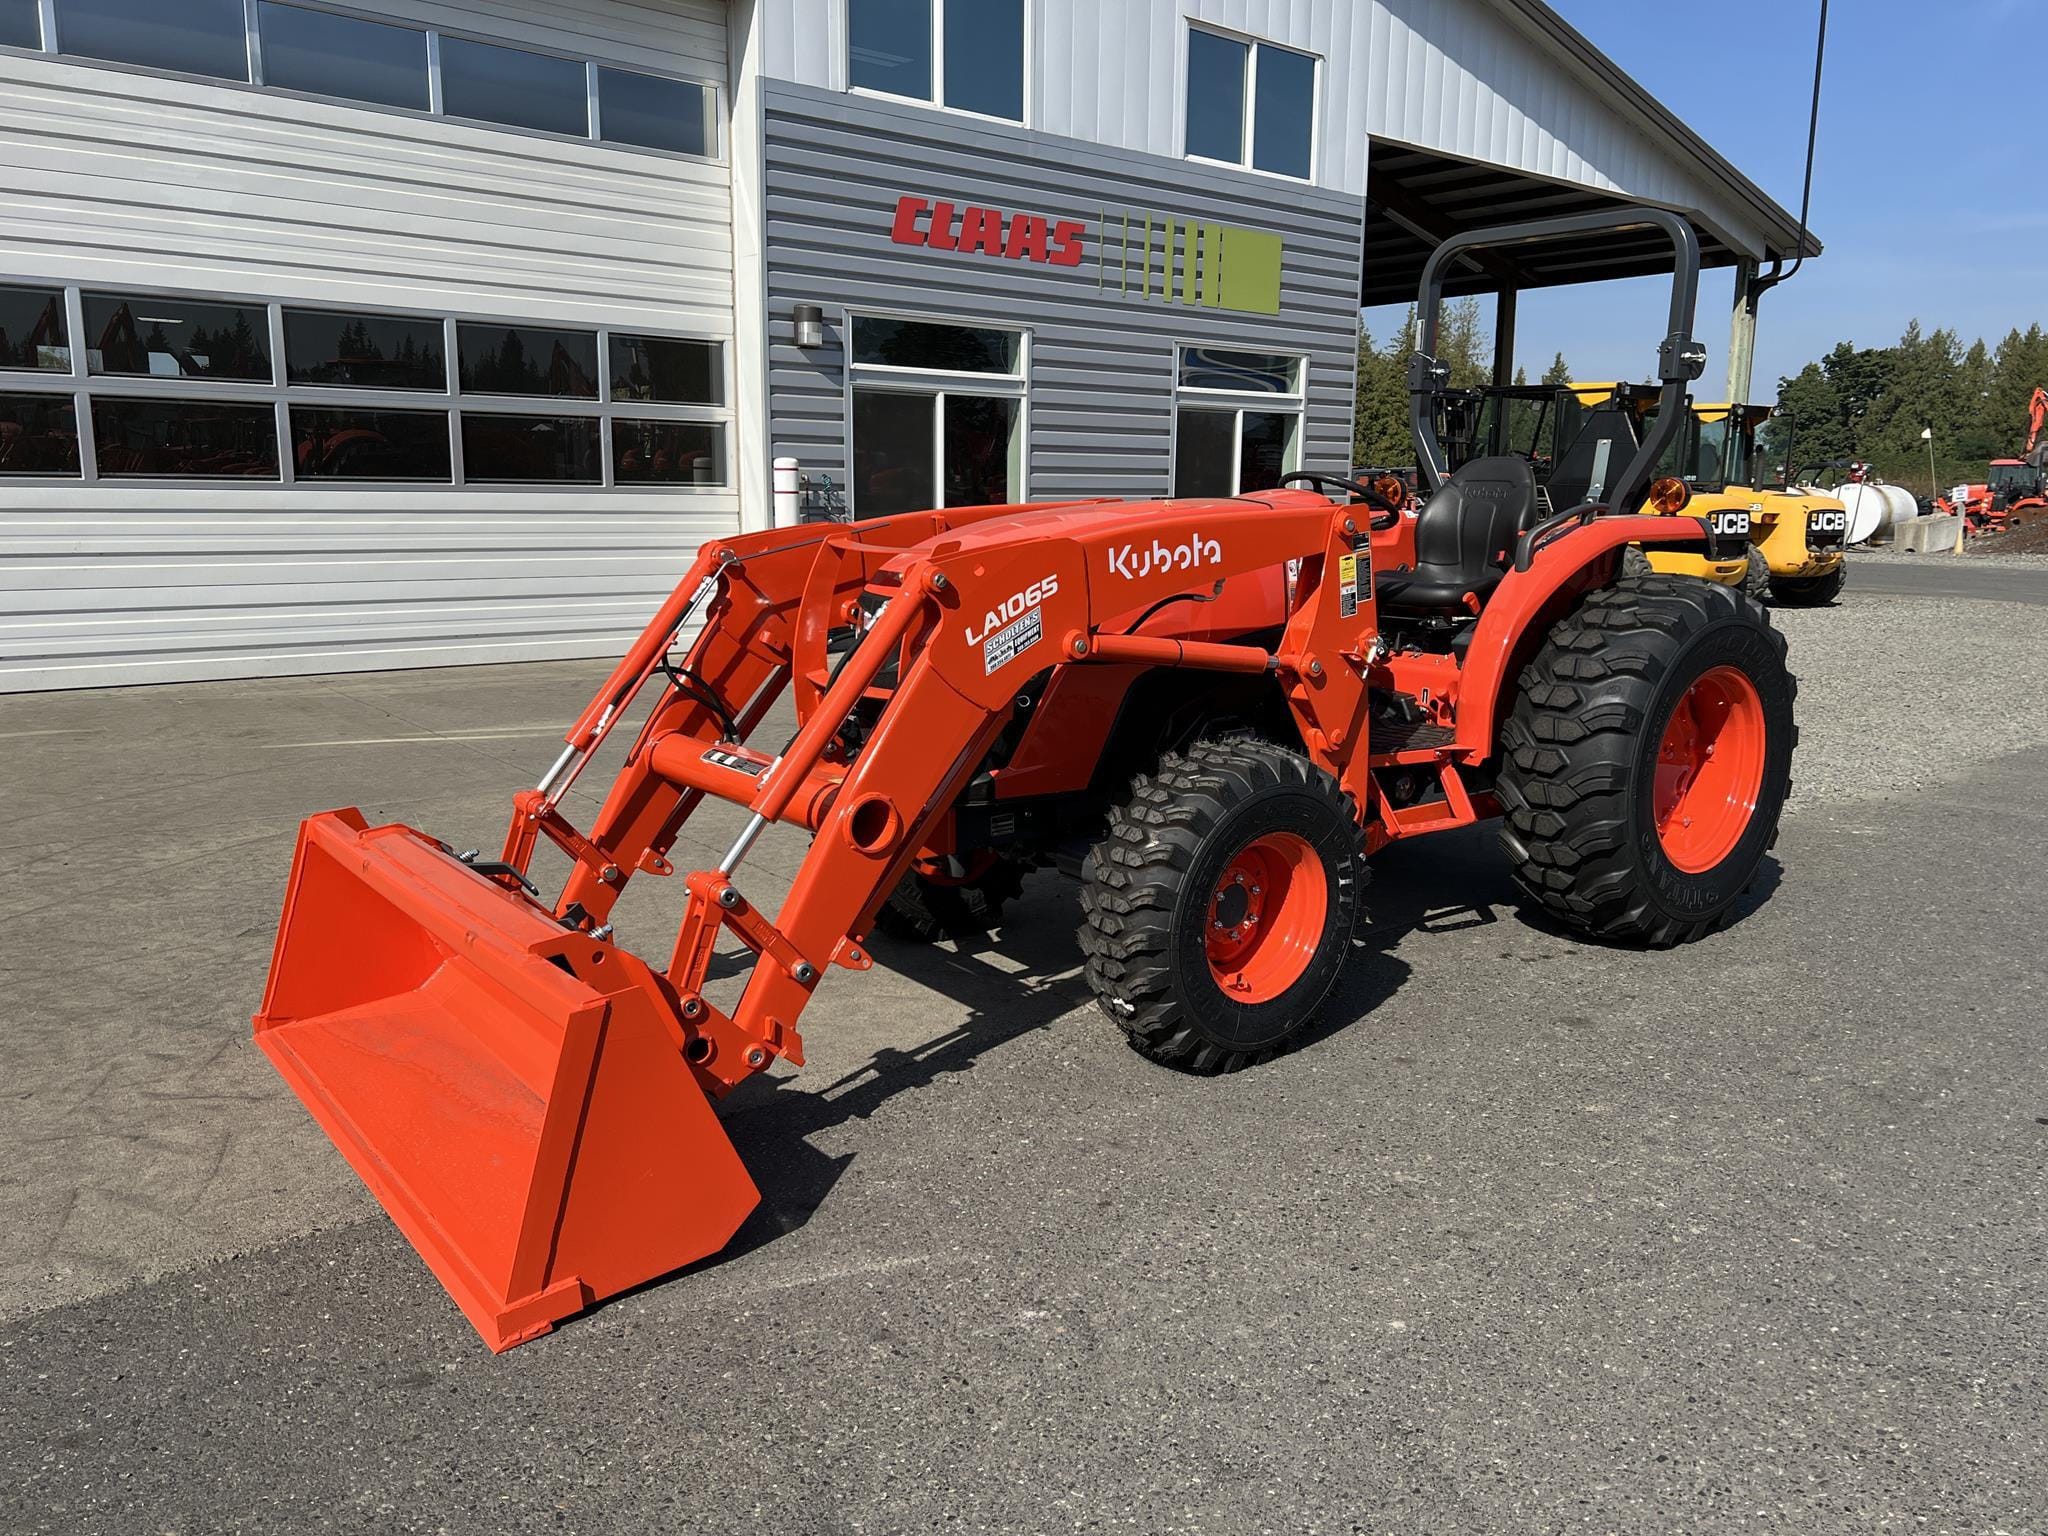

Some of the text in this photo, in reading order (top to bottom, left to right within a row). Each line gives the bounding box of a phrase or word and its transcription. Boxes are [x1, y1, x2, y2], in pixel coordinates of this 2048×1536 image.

[890, 196, 1086, 268] CLAAS
[1711, 513, 1750, 535] JCB
[1811, 512, 1846, 531] JCB
[1108, 533, 1222, 581] Kubota
[964, 573, 1059, 647] LA1065
[986, 611, 1039, 653] SCHOLTEN'S
